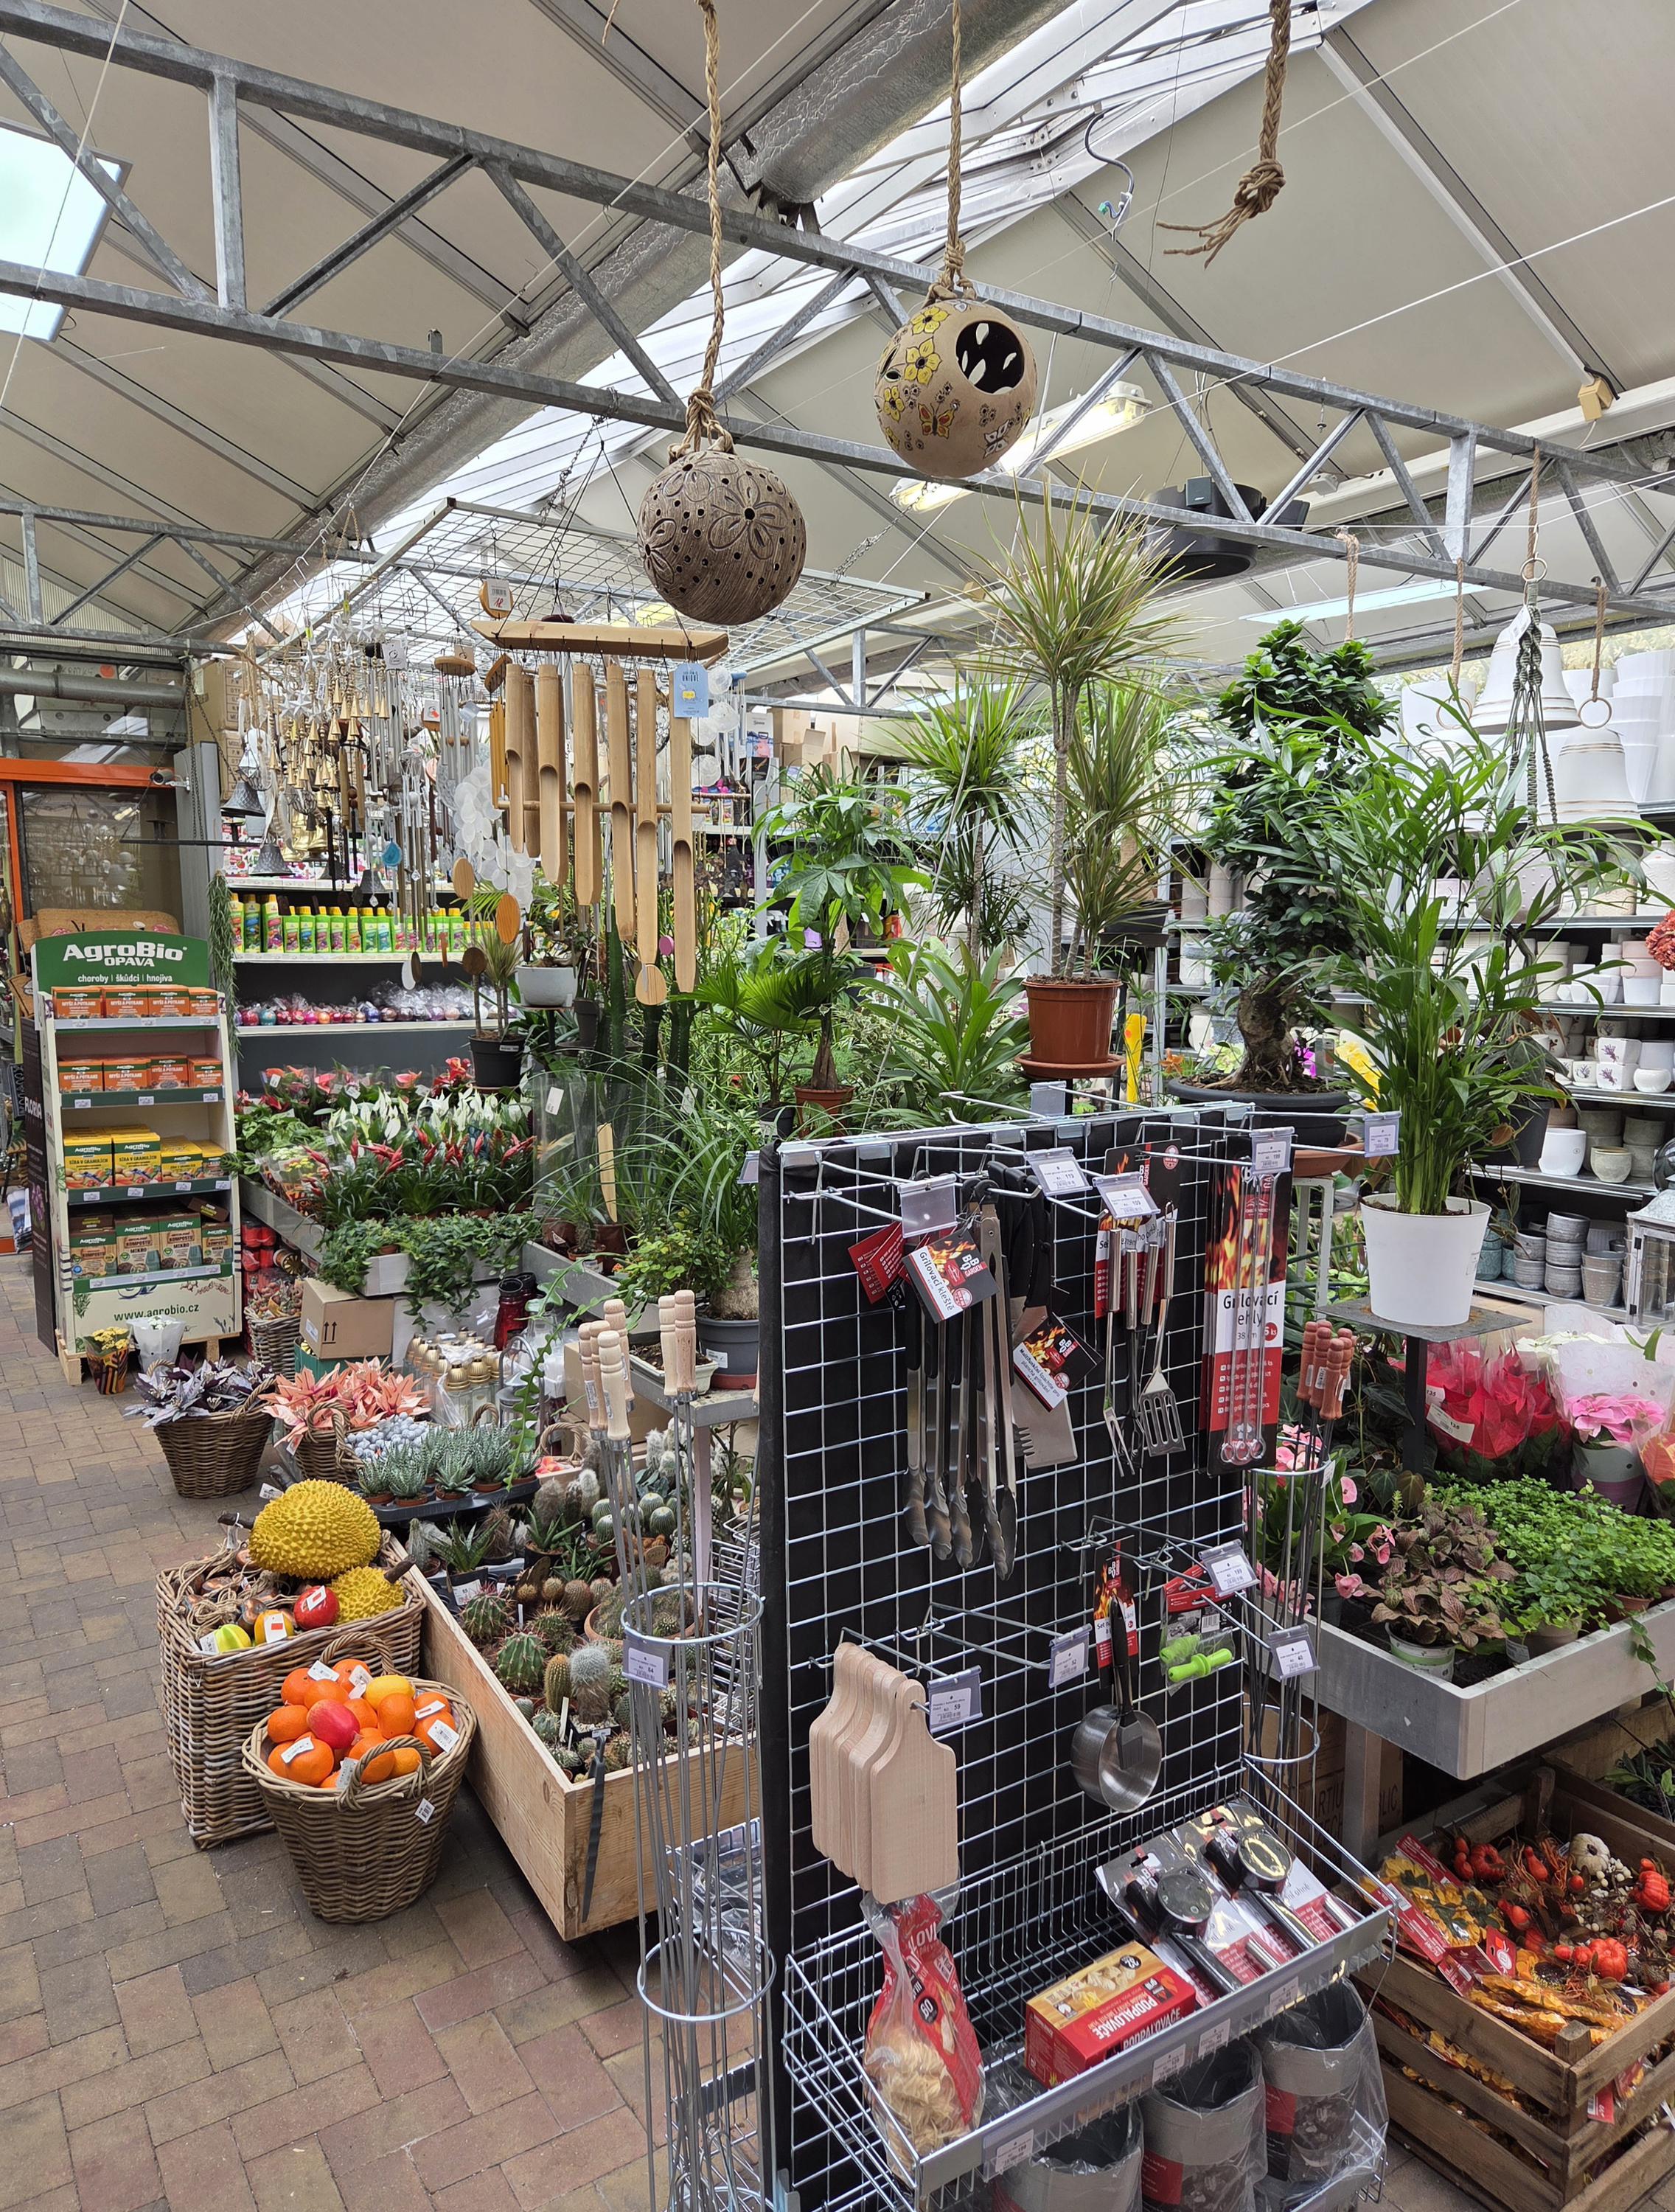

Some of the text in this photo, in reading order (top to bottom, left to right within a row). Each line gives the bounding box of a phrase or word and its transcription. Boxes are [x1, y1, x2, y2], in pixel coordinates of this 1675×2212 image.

[63, 942, 184, 962] AgroBio
[104, 957, 155, 967] OPAVA
[77, 973, 173, 984] choroby škůdci hnojiva
[919, 1251, 955, 1311] Grilovací kleště
[920, 1998, 933, 2020] 60
[1091, 1993, 1158, 2039] PODPALOVAČE
